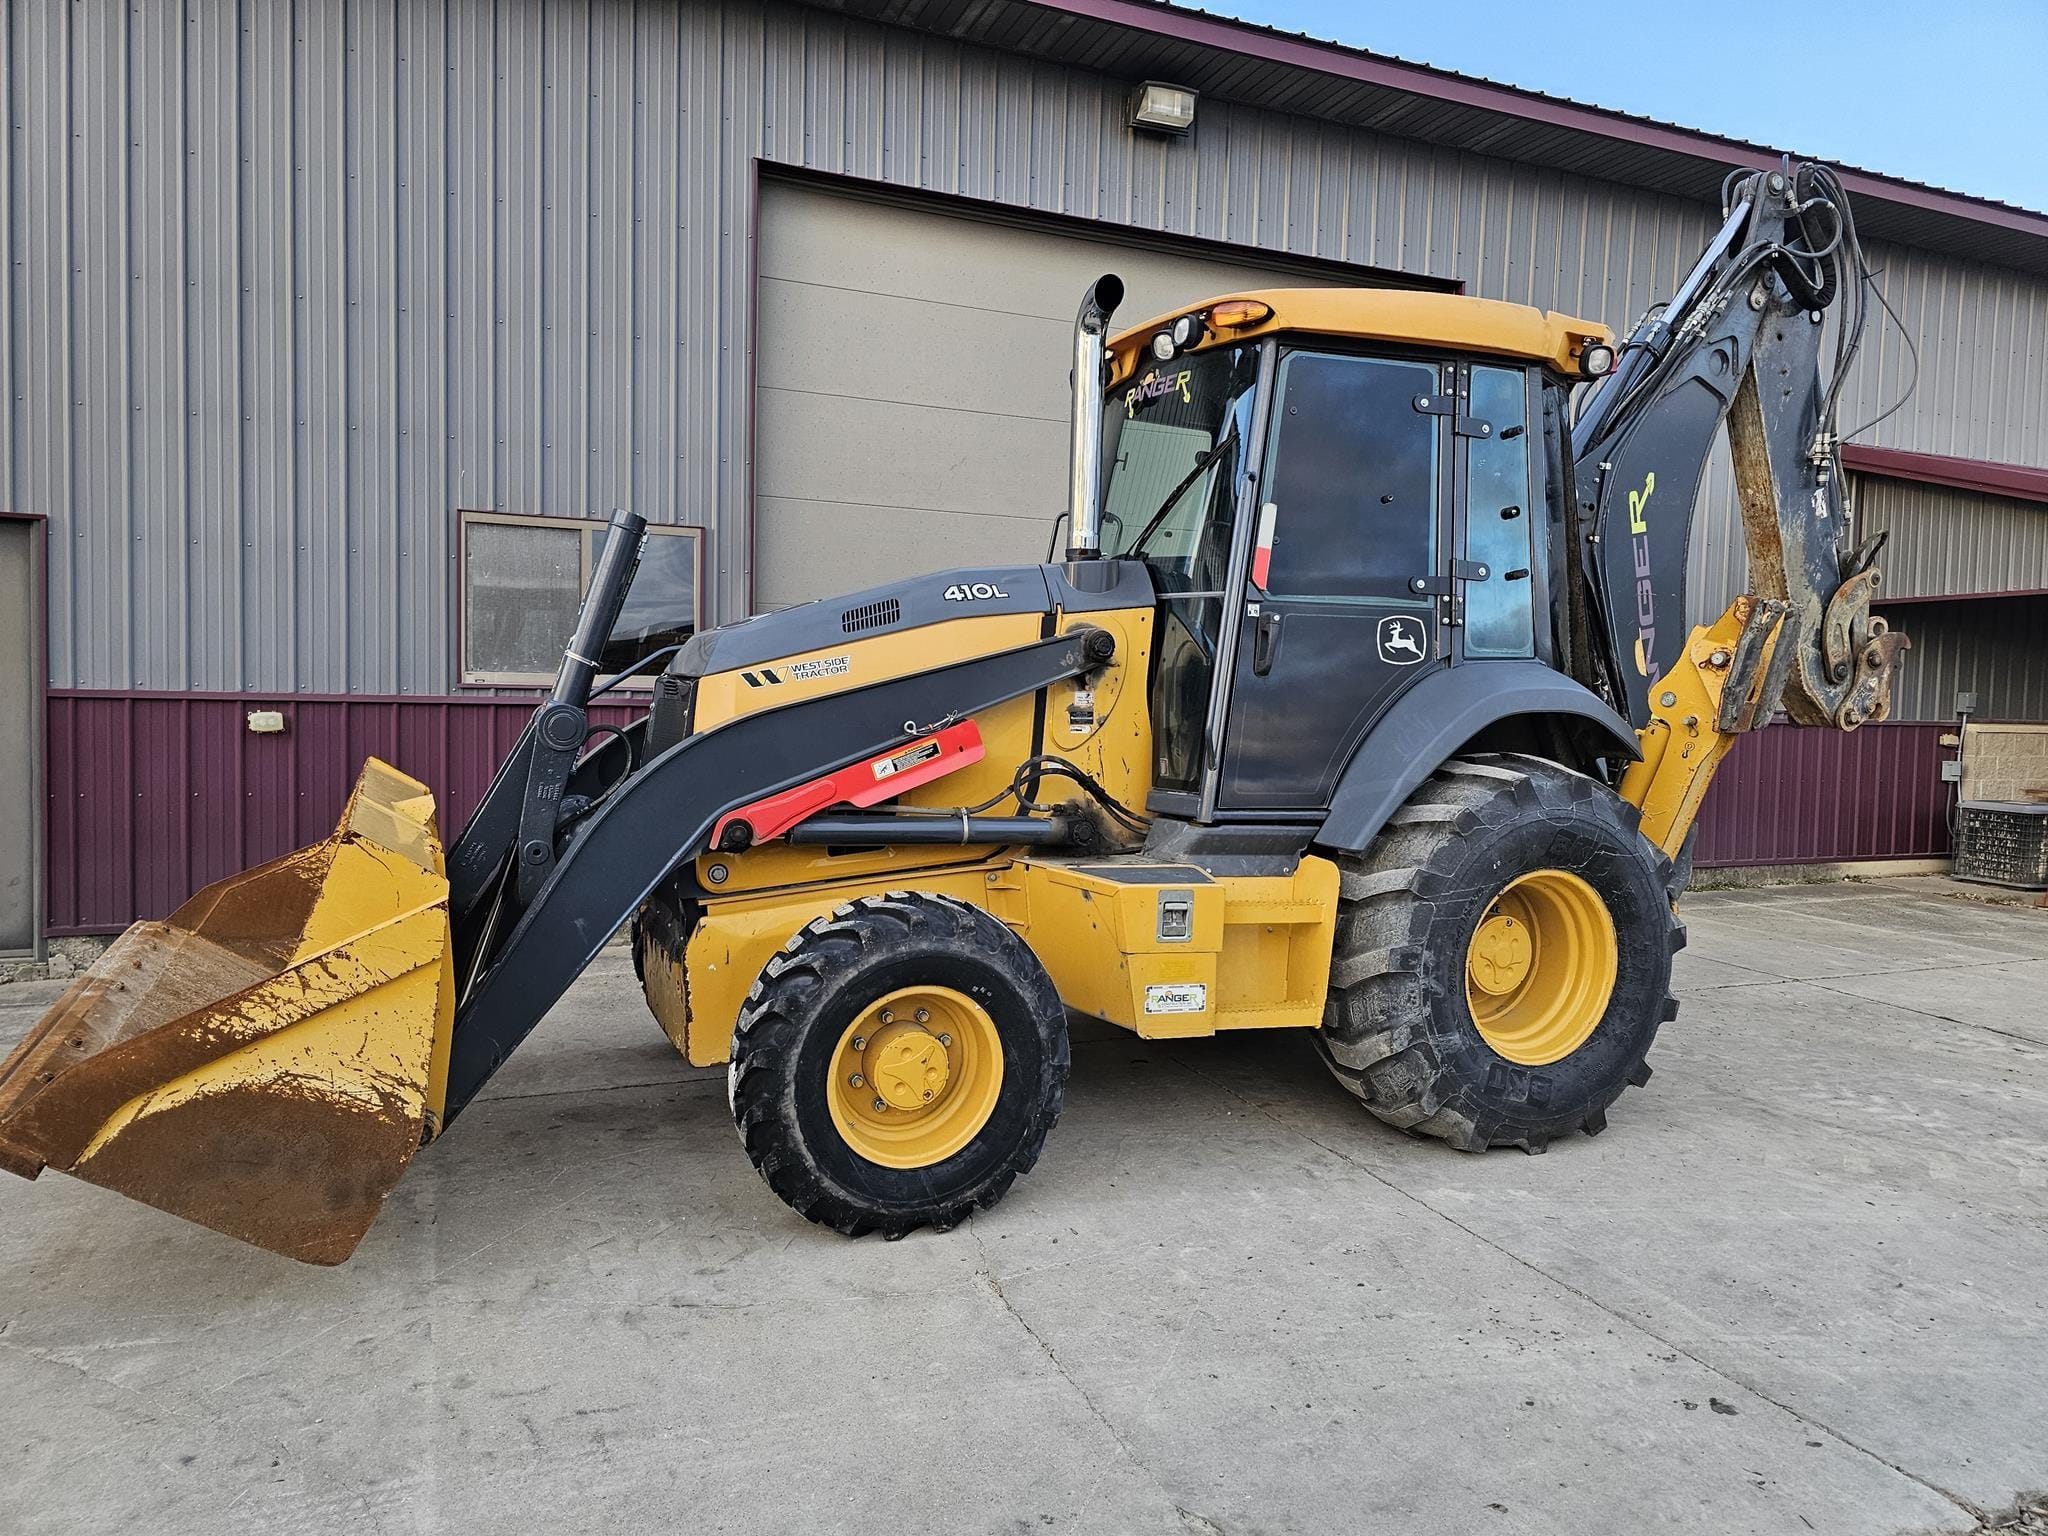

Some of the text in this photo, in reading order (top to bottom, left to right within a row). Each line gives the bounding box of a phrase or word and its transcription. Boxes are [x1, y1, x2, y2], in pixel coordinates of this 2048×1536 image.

[1124, 369, 1191, 418] RANGER
[943, 583, 1010, 601] 410L
[1629, 472, 1662, 719] NGER
[791, 656, 849, 673] WEST SIDE
[793, 665, 848, 680] TRACTOR
[1151, 993, 1199, 1008] RANGER
